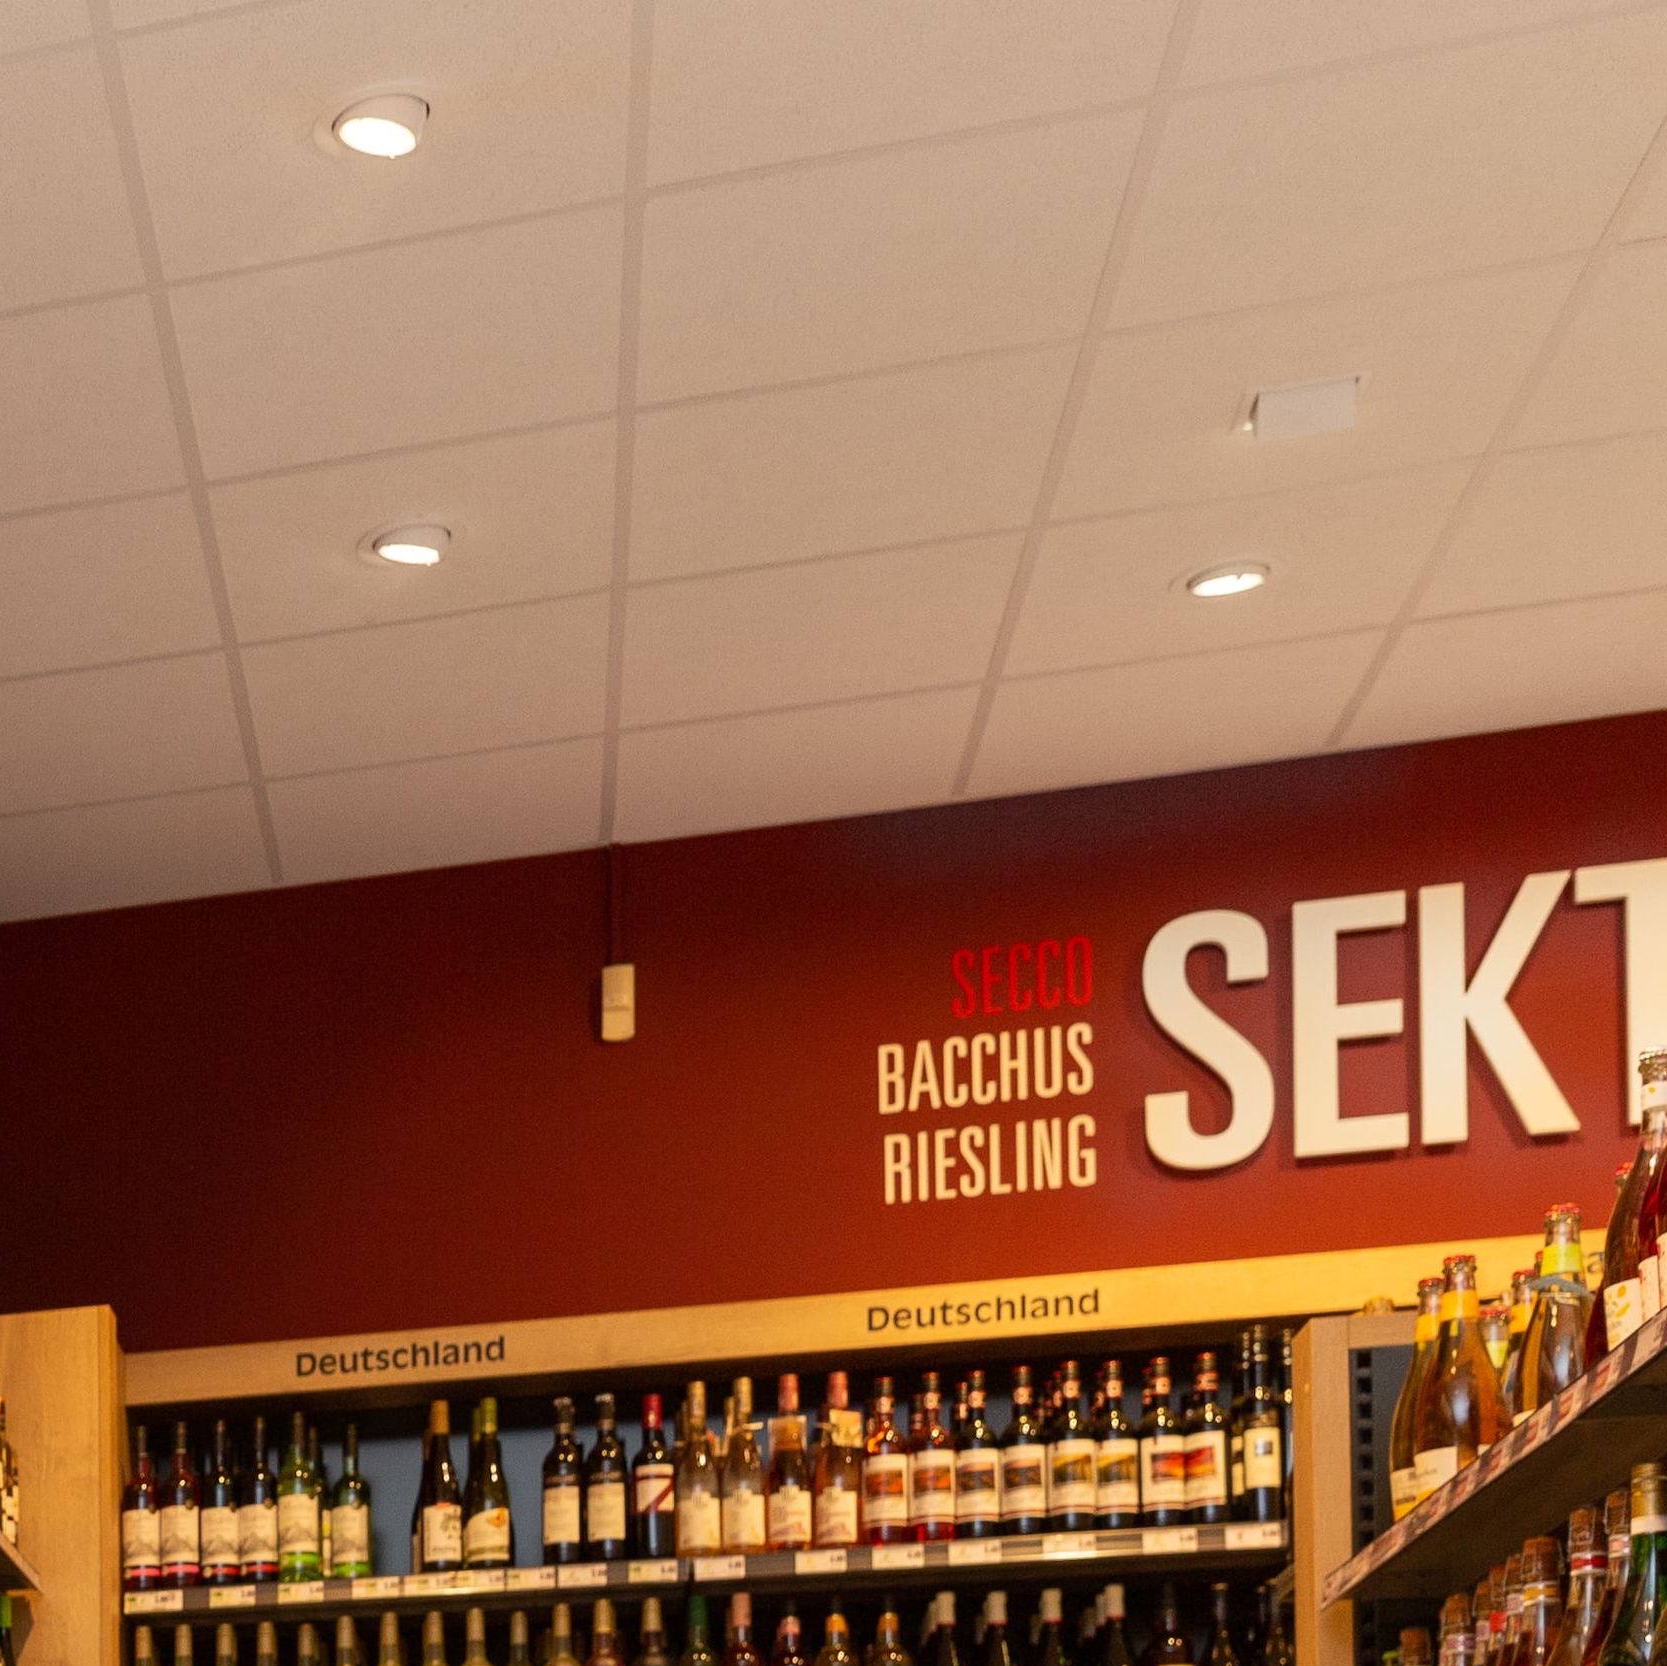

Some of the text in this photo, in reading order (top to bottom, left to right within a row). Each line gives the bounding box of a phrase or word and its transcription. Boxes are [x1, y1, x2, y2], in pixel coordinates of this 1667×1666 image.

[952, 935, 1093, 1019] SECCO
[877, 1022, 1094, 1115] BACCHUS
[884, 1113, 1097, 1204] RIESLING
[868, 1288, 1101, 1332] Deutschland
[296, 1335, 506, 1377] Deutschland
